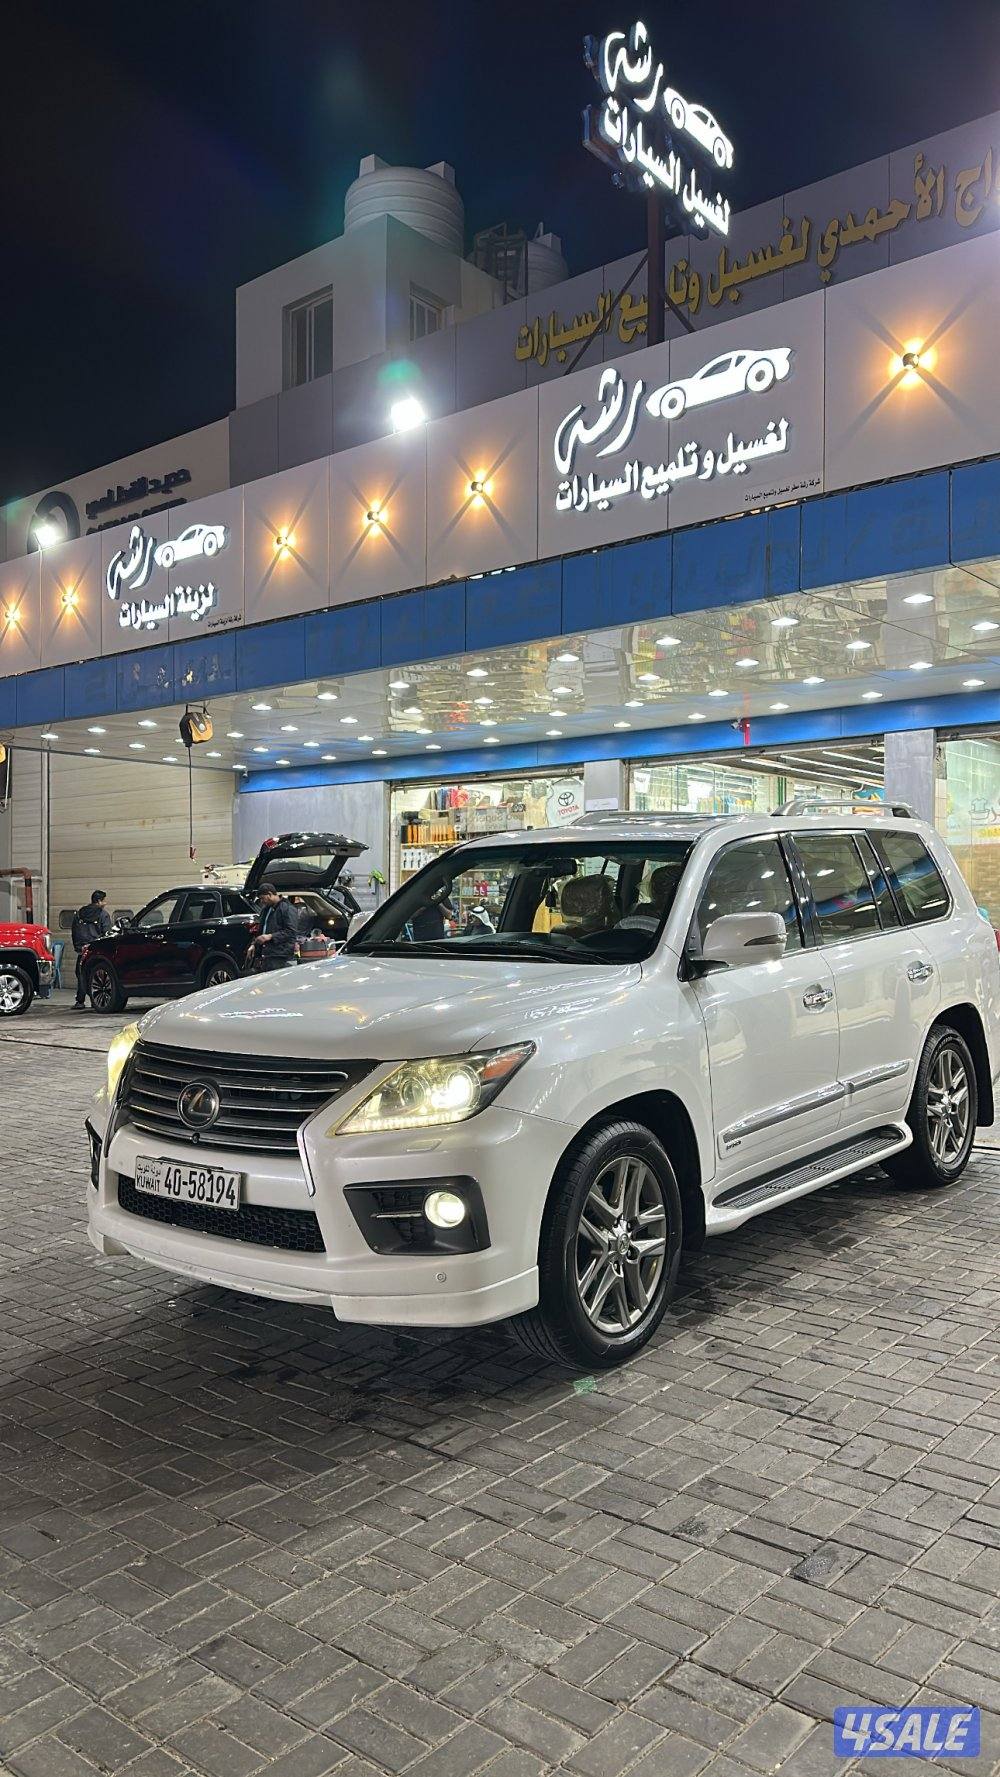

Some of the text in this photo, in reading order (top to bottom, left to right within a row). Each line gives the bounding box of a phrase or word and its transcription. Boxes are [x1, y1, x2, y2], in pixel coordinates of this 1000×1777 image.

[604, 96, 730, 235] لغسيل السيارات
[706, 215, 810, 306] لغسيل
[515, 289, 613, 366] السيارات
[716, 417, 789, 475] لغسيل
[555, 460, 640, 511] السيارات
[119, 582, 215, 630] لزينة السيارات
[558, 804, 579, 816] TOYOTA
[136, 1174, 161, 1193] KUWAIT
[164, 1166, 236, 1206] 40-58194
